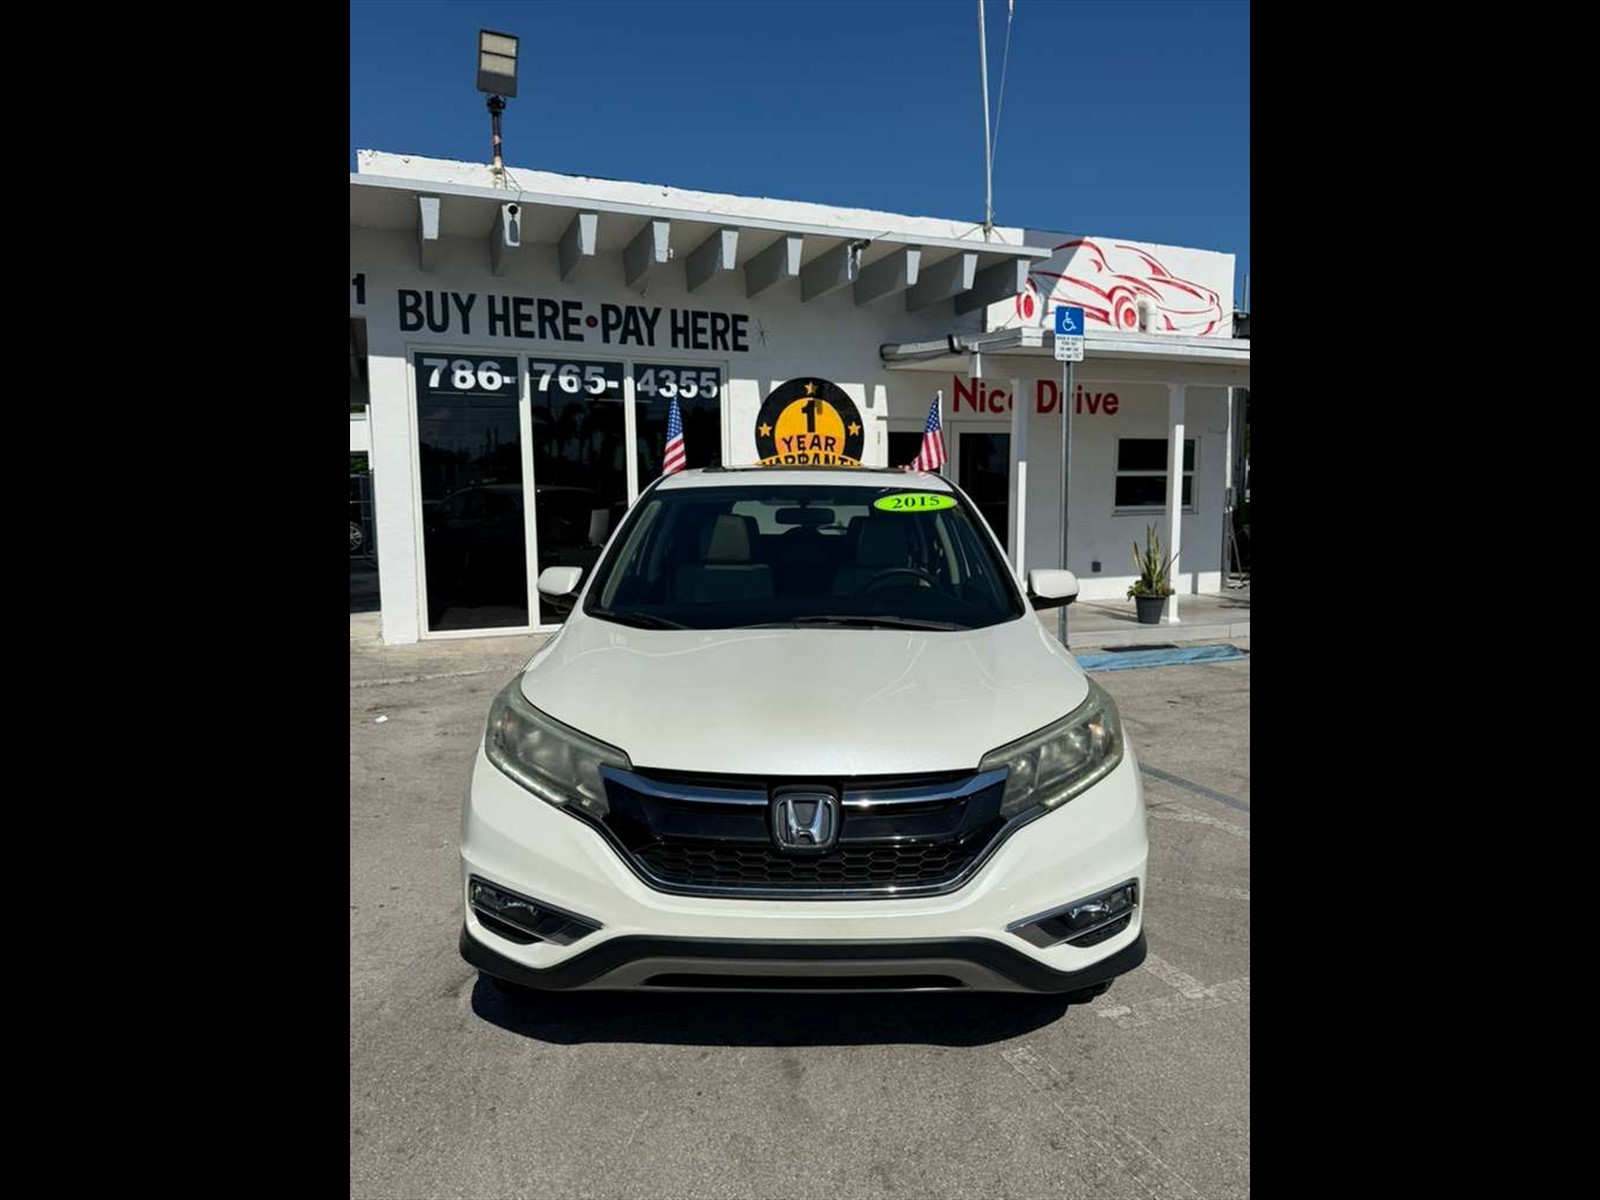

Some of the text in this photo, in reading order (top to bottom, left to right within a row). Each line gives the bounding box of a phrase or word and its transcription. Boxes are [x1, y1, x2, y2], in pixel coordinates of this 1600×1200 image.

[398, 289, 749, 352] BUY HERE PAY HERE
[423, 357, 718, 399] 786- 765- 4355
[801, 399, 816, 433] 1
[782, 434, 837, 452] YEAR
[891, 495, 940, 509] 2015
